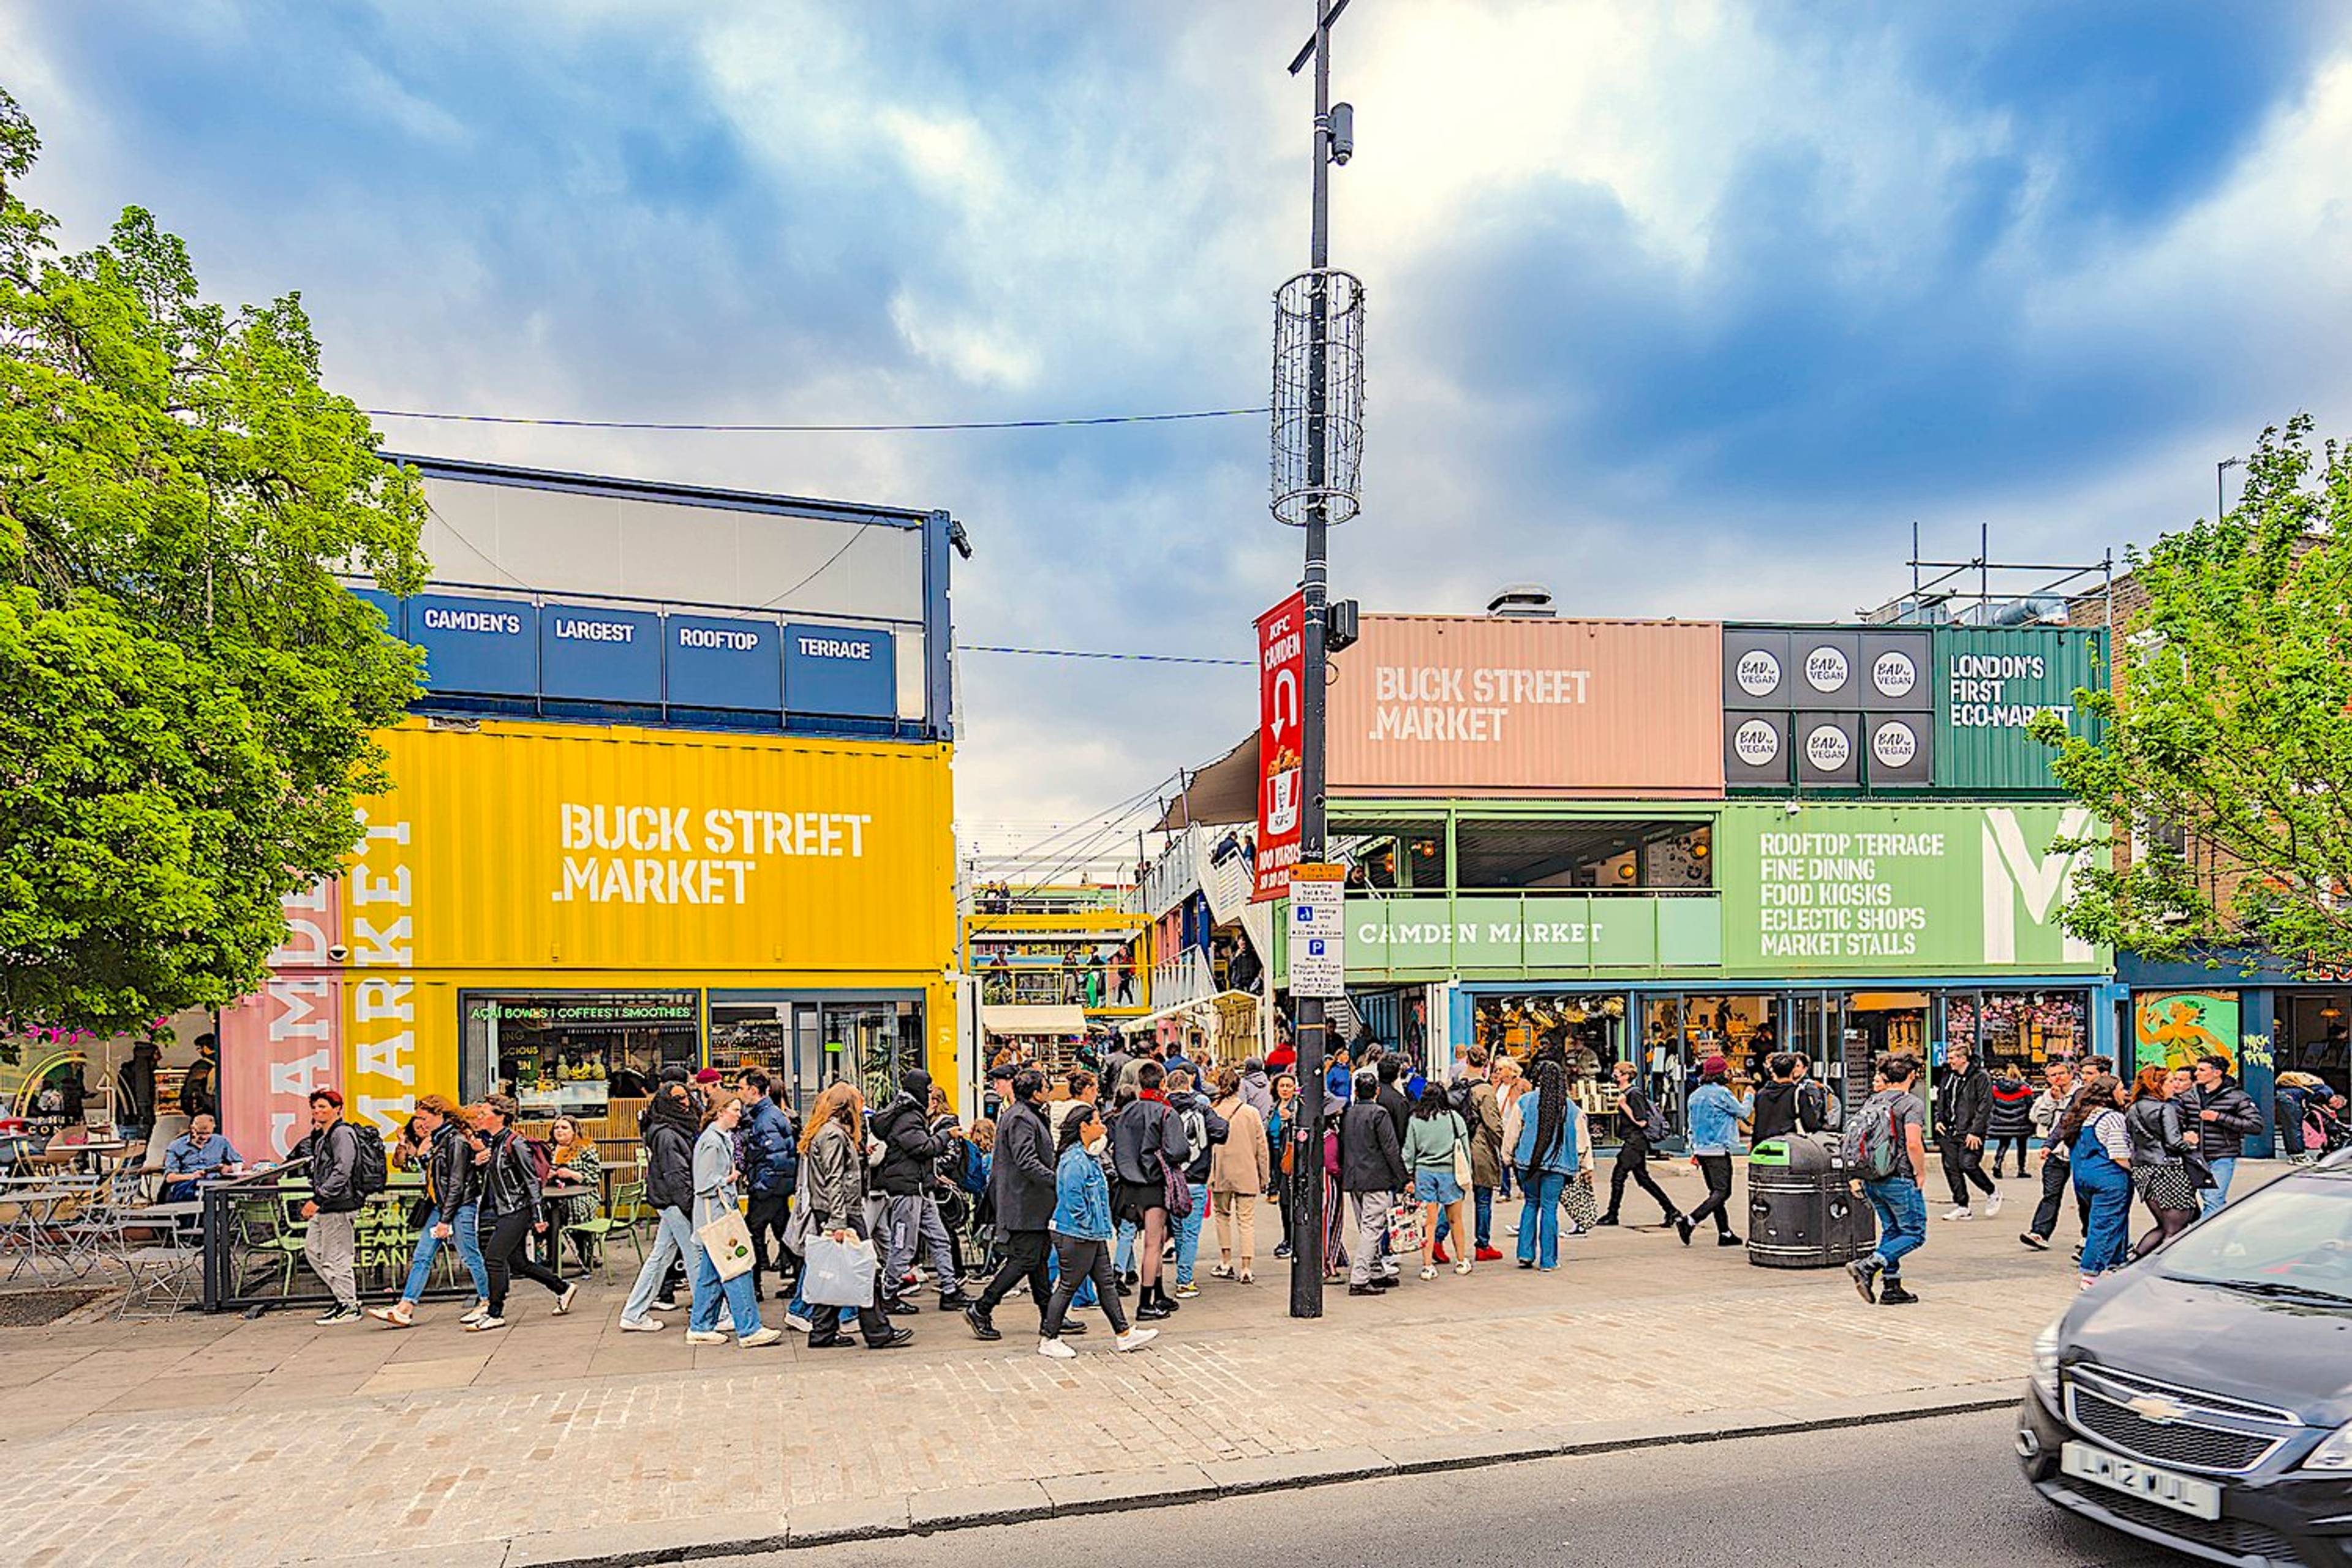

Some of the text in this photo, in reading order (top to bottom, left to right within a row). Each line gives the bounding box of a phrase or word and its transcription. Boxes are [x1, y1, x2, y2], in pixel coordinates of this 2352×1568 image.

[425, 609, 870, 659] CAMDEN'S LARGEST ROOFTOP TERRACE
[1264, 631, 1300, 672] CAMDEN
[1741, 662, 1768, 674] BAD
[1810, 657, 1836, 671] BAD
[1878, 663, 1904, 675] BAD
[1950, 655, 2044, 679] LONDON'S
[1741, 675, 1775, 684] VEGAN
[1809, 671, 1844, 680] VEGAN
[1877, 676, 1910, 685] VEGAN
[1376, 666, 1591, 703] BUCK STREET
[1950, 679, 2004, 702] FIRST
[1740, 731, 1766, 744] BAD
[1811, 737, 1838, 748] BAD
[1879, 734, 1904, 745] BAD
[1740, 744, 1774, 753] VEGAN
[1811, 750, 1845, 758] VEGAN
[1878, 746, 1911, 755] VEGAN
[560, 803, 872, 857] BUCK STREET
[1760, 833, 1944, 856] ROOFTOP TERRACE
[1760, 859, 1875, 880] FINE DINING
[1760, 883, 1891, 905] FOOD KIOSKS
[1760, 908, 1926, 930] ECLECTIC SHOPS
[1359, 923, 1603, 943] CAMDEN MARKET
[1760, 933, 1915, 956] MARKET STALLS
[505, 1008, 548, 1019] BOWLS
[558, 1008, 611, 1019] COFFEES
[622, 1006, 692, 1018] SMOOTHIES
